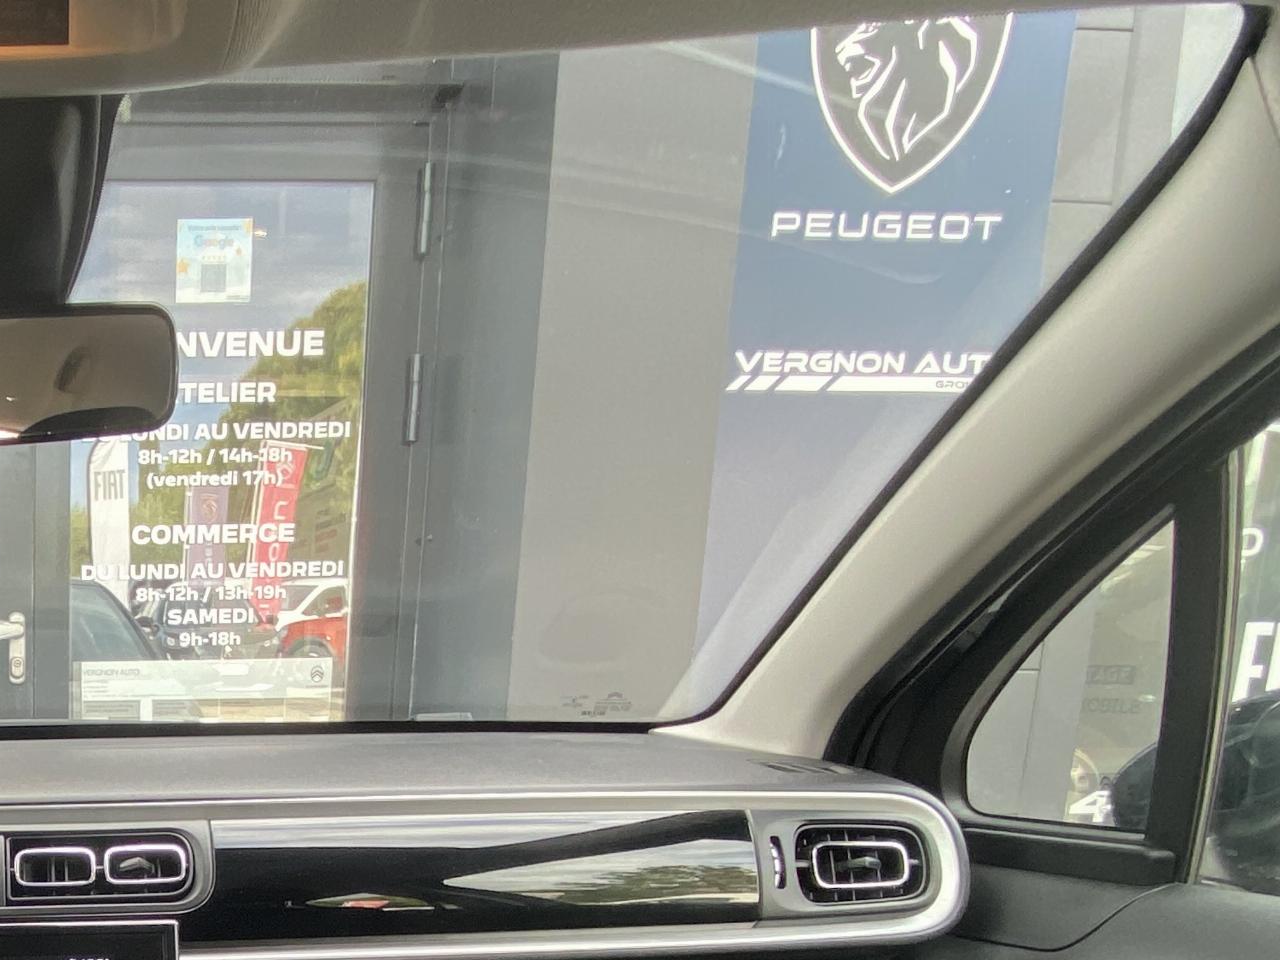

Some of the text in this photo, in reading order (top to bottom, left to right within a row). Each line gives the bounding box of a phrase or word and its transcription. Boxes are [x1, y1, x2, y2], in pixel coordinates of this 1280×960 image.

[771, 211, 1003, 241] PEUGEOT
[176, 330, 325, 358] NVENUE
[735, 351, 993, 375] VERGNON AUT
[177, 382, 277, 403] TELIER
[194, 422, 228, 441] AU
[233, 421, 351, 440] VENDREDI
[138, 448, 202, 465] 8h-12h
[219, 448, 293, 464] 14h-18h
[93, 469, 127, 501] FIAT
[147, 470, 283, 490] (vendredi 17h)
[131, 523, 296, 545] COMMERCE
[81, 560, 344, 580] DU LUNDI AU VENDREDI
[135, 586, 199, 602] 8h-12h
[215, 584, 287, 601] 13h-19h
[167, 608, 256, 625] SAMEDI
[179, 631, 241, 647] 9h-18h
